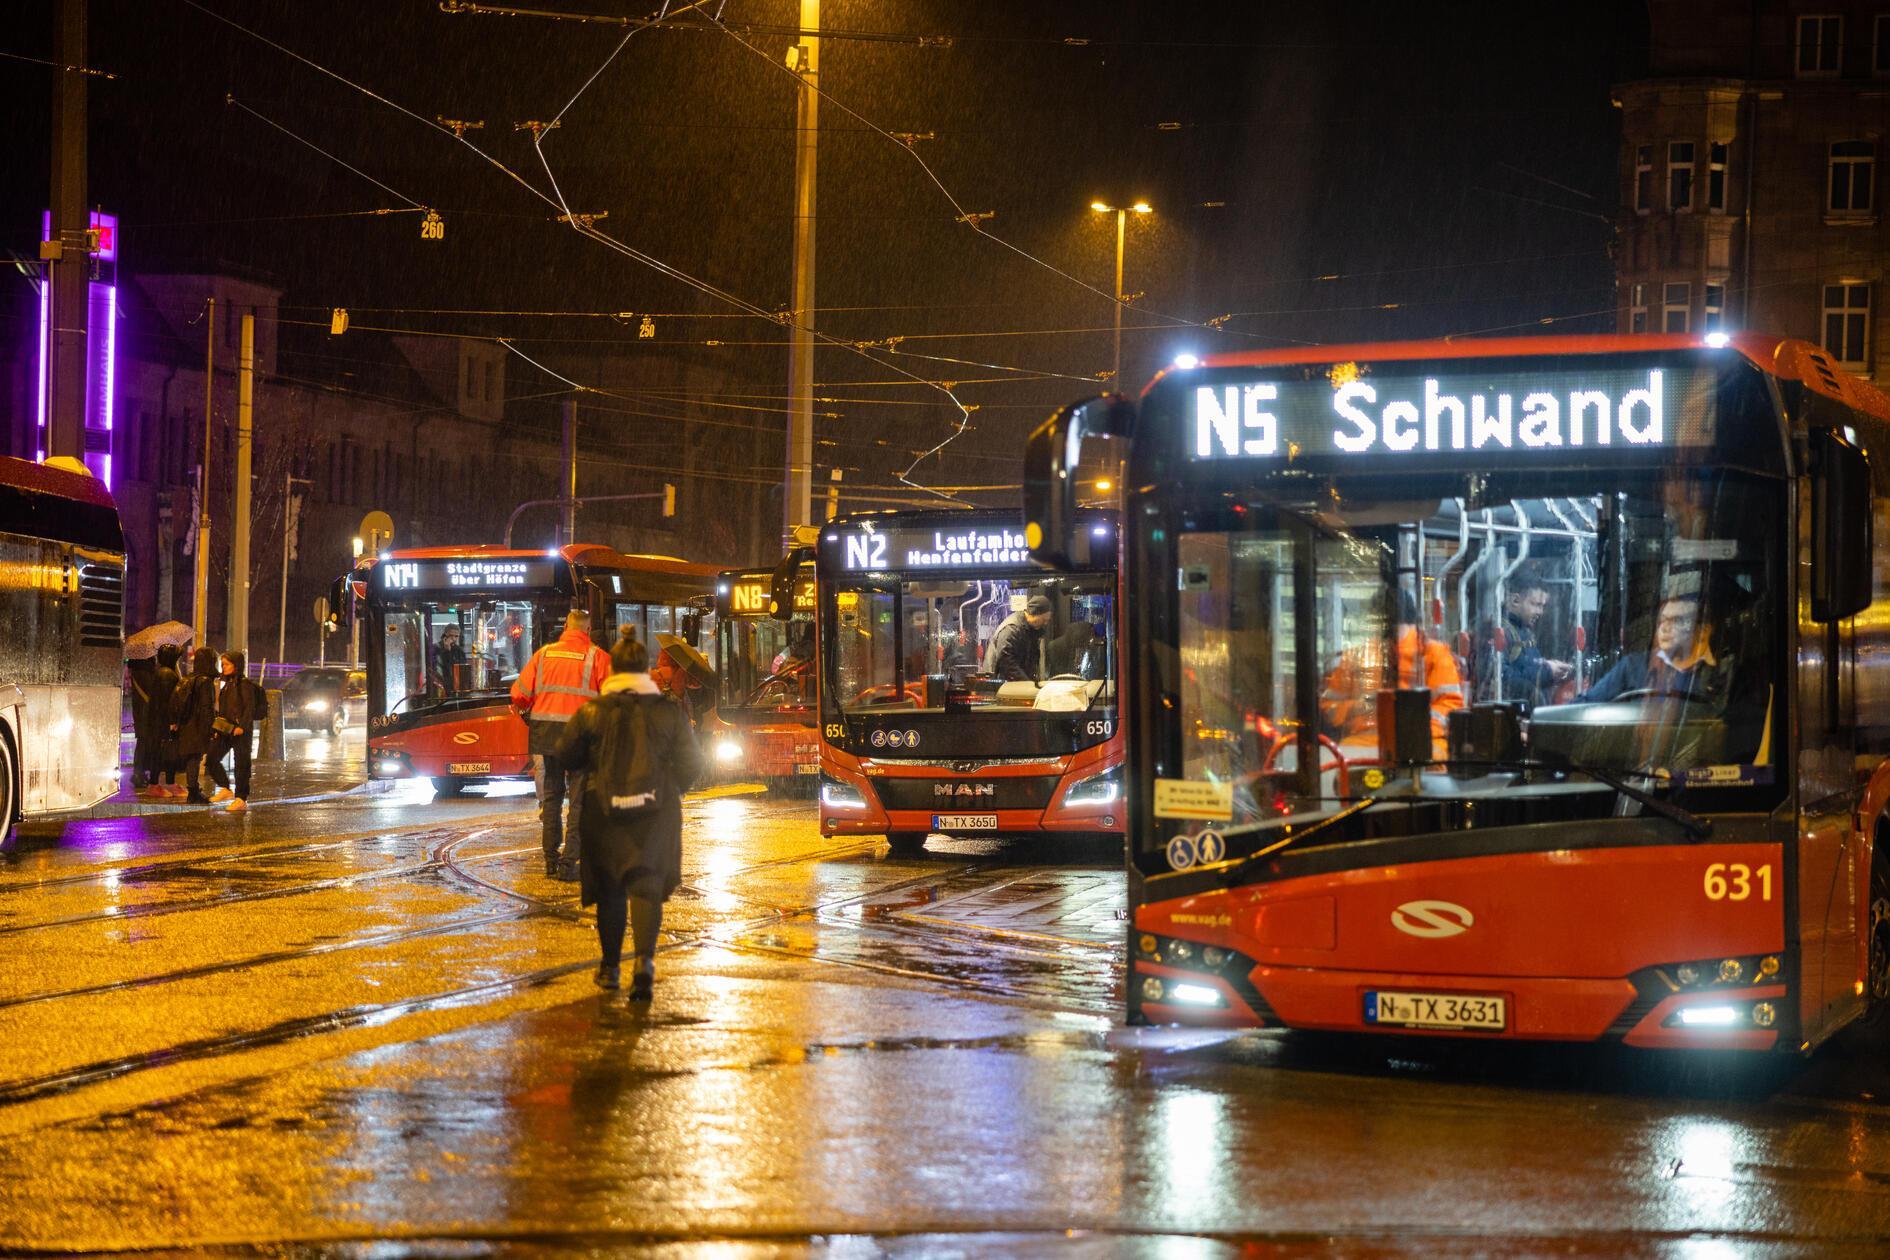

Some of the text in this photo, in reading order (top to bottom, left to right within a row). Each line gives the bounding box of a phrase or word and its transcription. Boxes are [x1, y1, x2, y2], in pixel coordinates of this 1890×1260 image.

[421, 220, 445, 240] 260
[639, 323, 655, 338] 250
[1196, 368, 1663, 456] N5 Schwand
[847, 534, 887, 568] N2
[447, 563, 527, 575] Stadtgrenze
[451, 573, 524, 585] über Höfen
[734, 585, 762, 610] N8
[1087, 720, 1112, 735] 650
[471, 763, 489, 772] 3644
[934, 783, 994, 796] MAN
[969, 817, 996, 828] 3650
[1703, 863, 1771, 901] 631
[1410, 998, 1439, 1020] TX
[1444, 1000, 1501, 1024] 3631
